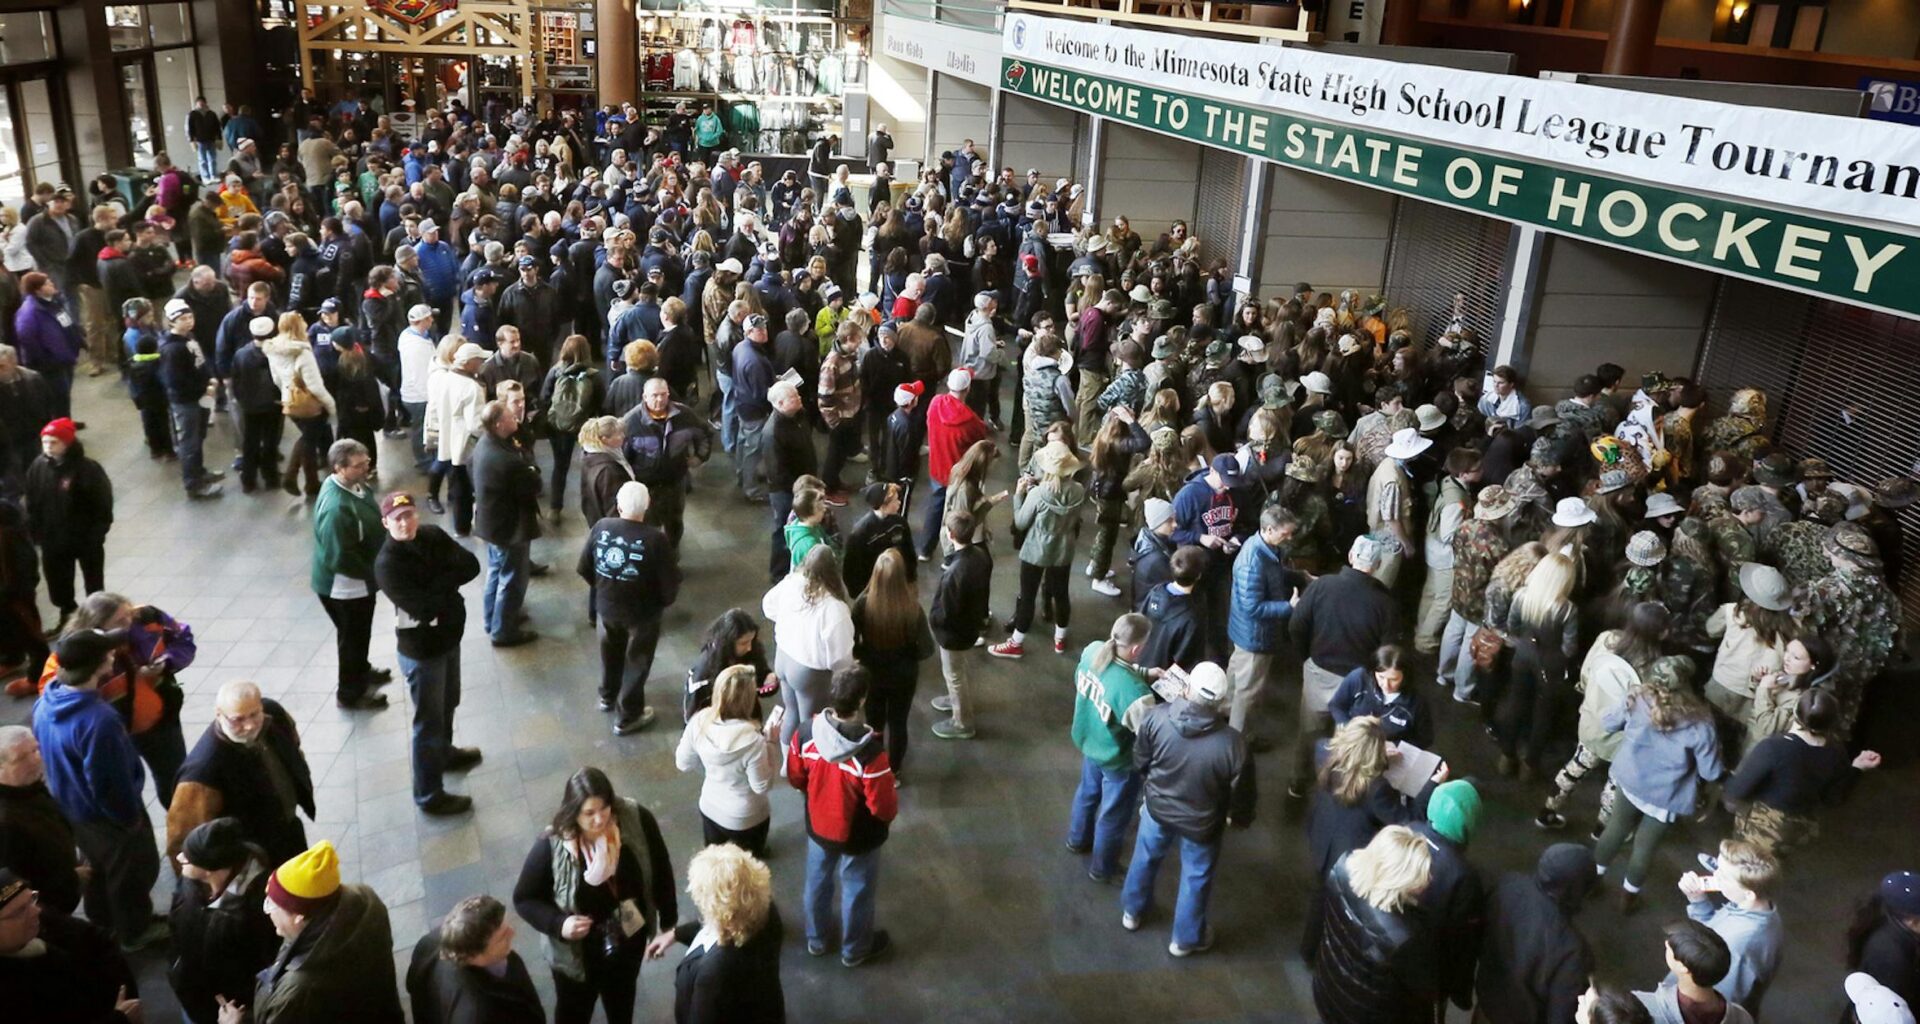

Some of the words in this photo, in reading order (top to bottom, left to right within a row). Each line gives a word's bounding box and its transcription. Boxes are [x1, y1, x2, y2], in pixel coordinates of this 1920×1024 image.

[946, 50, 976, 74] Media
[1045, 31, 1099, 61] Welcome
[1105, 42, 1117, 63] to
[1124, 43, 1145, 68] the
[1151, 47, 1249, 87] Minnesota
[1256, 61, 1312, 97] State
[1320, 72, 1387, 116] High
[1397, 82, 1505, 129] School
[1513, 98, 1666, 159] League
[1032, 67, 1141, 119] WELCOME
[1152, 94, 1189, 130] TO
[1203, 105, 1269, 151] THE
[1284, 123, 1422, 187] STATE
[1445, 157, 1523, 206] OF
[1547, 177, 1906, 293] HOCKEY
